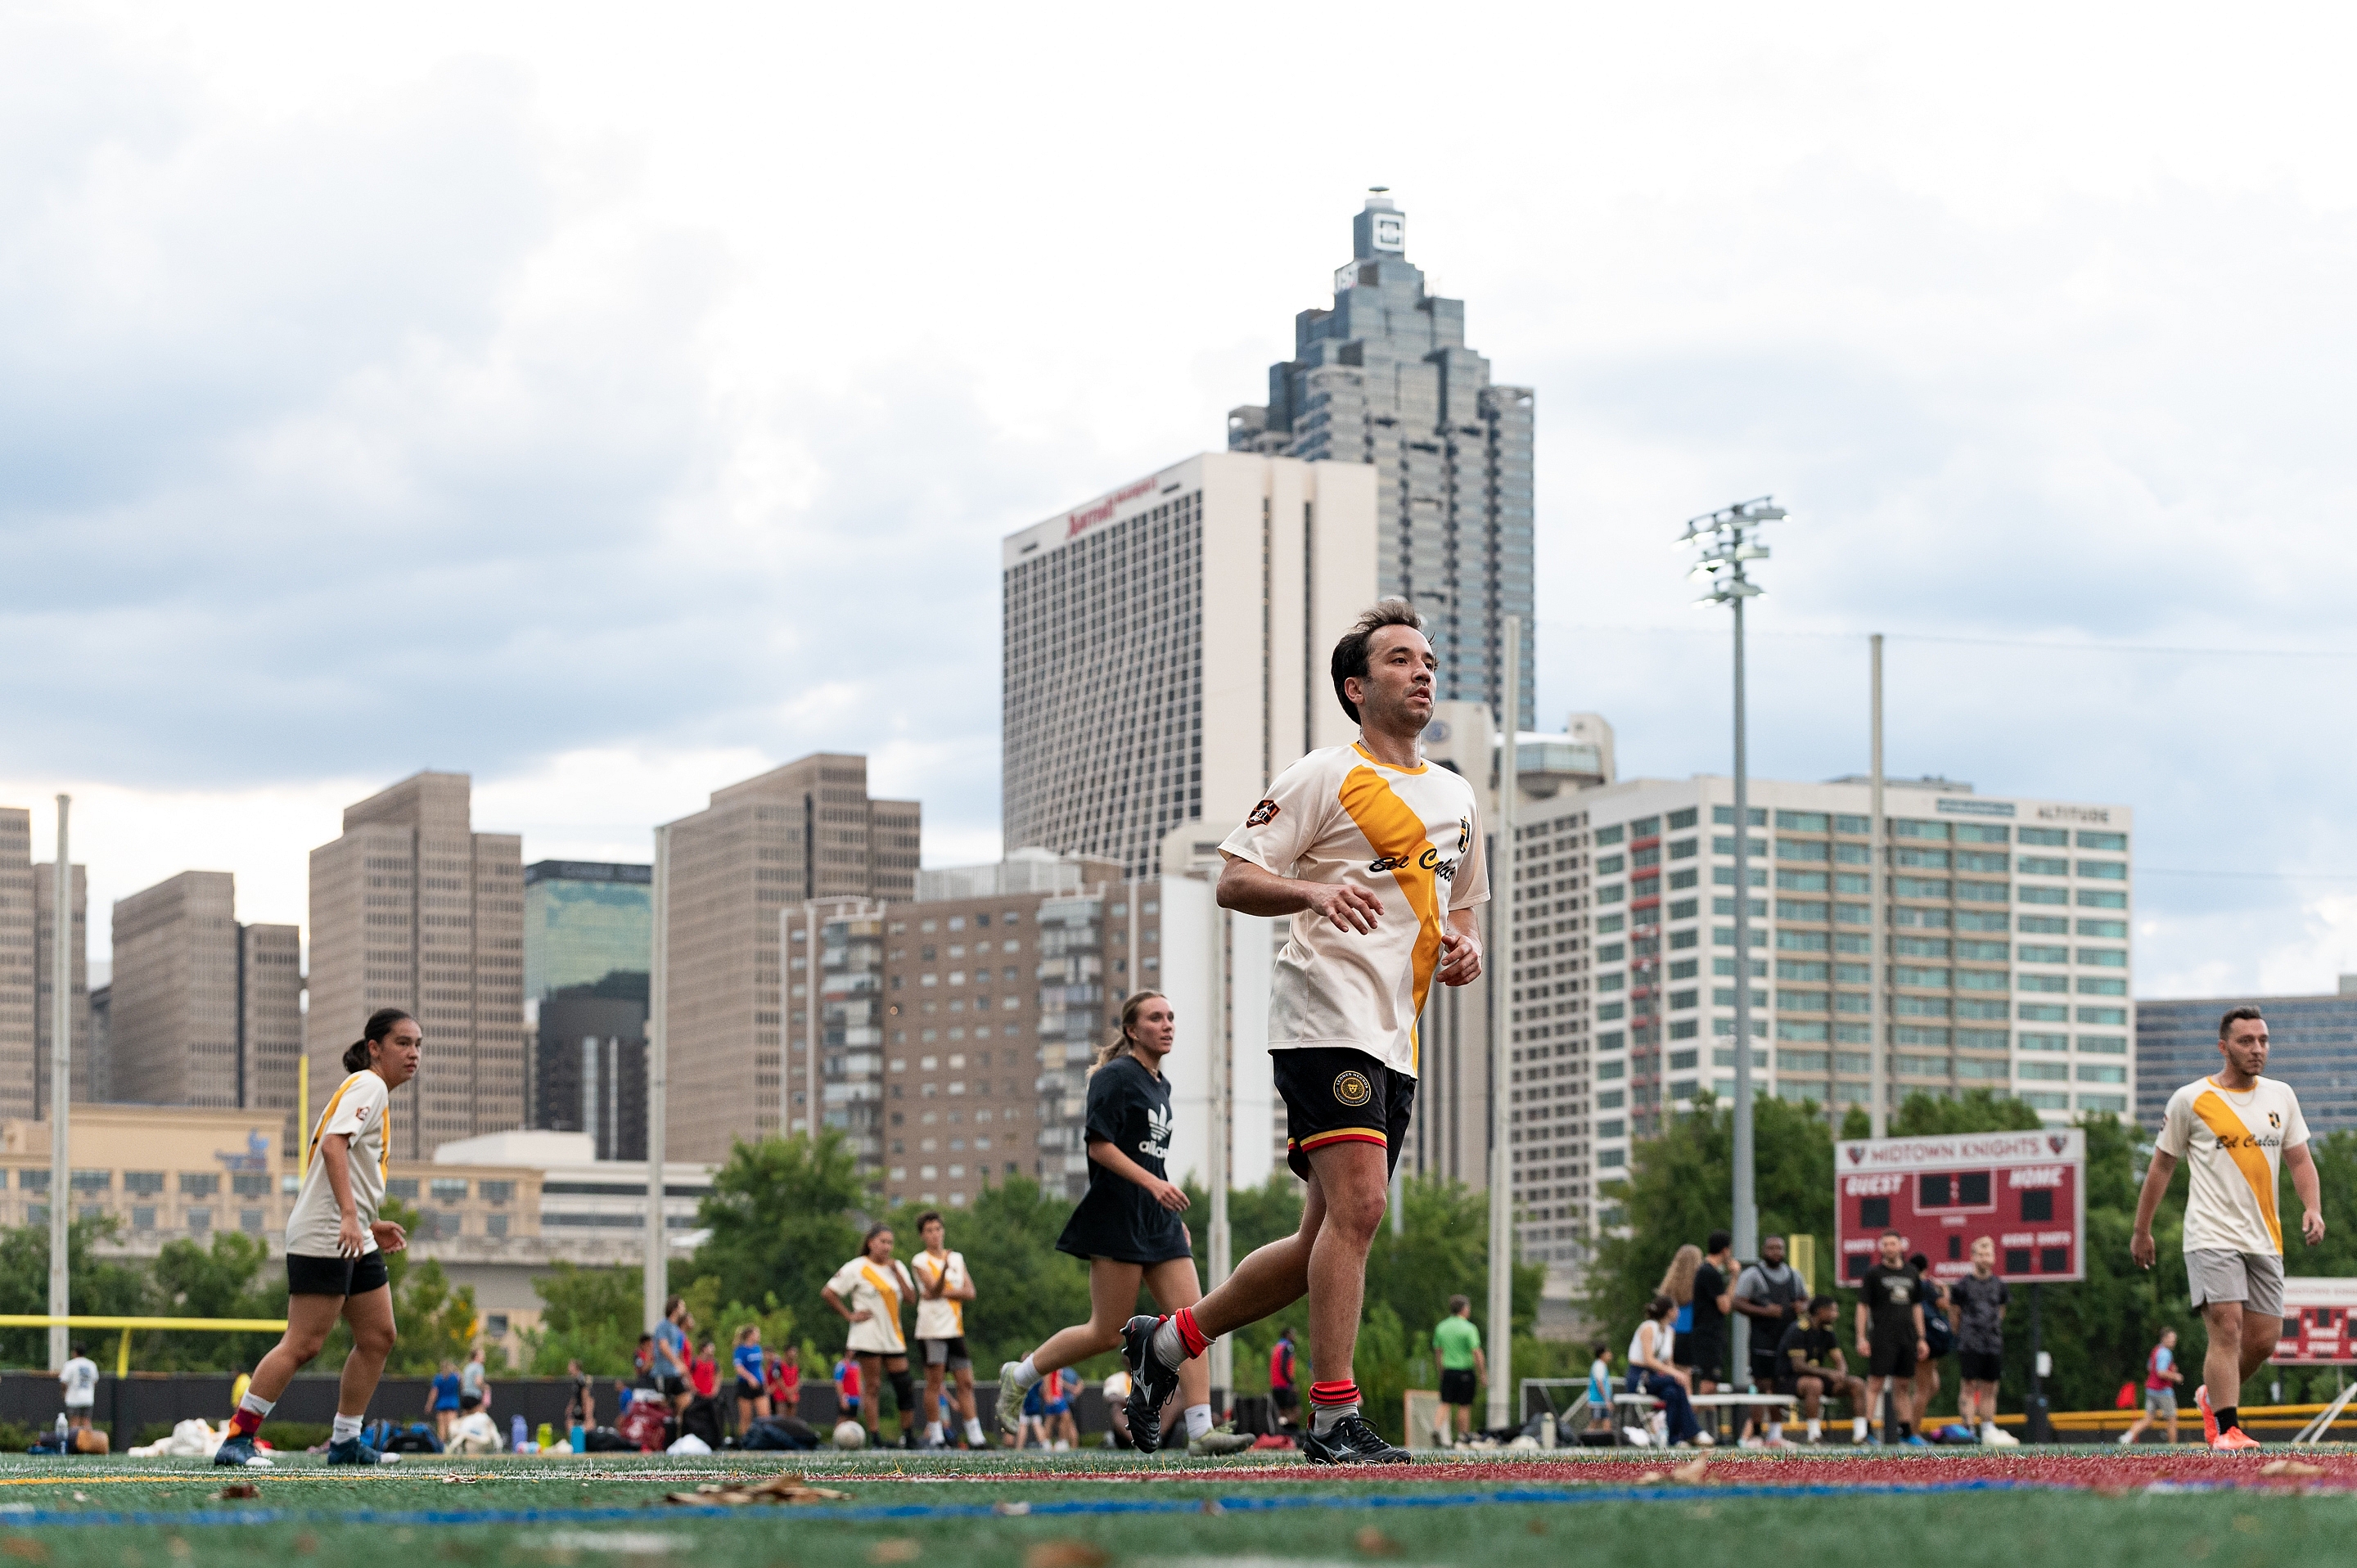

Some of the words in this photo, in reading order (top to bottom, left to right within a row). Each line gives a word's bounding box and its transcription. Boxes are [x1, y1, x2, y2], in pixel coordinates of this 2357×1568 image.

[1369, 856, 1409, 872] Bel
[1336, 1072, 1352, 1086] LEONES
[1872, 1142, 1954, 1162] MIDTOWN
[1960, 1137, 2040, 1156] KNIGHTS
[2215, 1134, 2239, 1150] Bel
[2243, 1133, 2280, 1148] Calcio
[1846, 1174, 1903, 1196] GUEST
[2008, 1167, 2065, 1188] HOME
